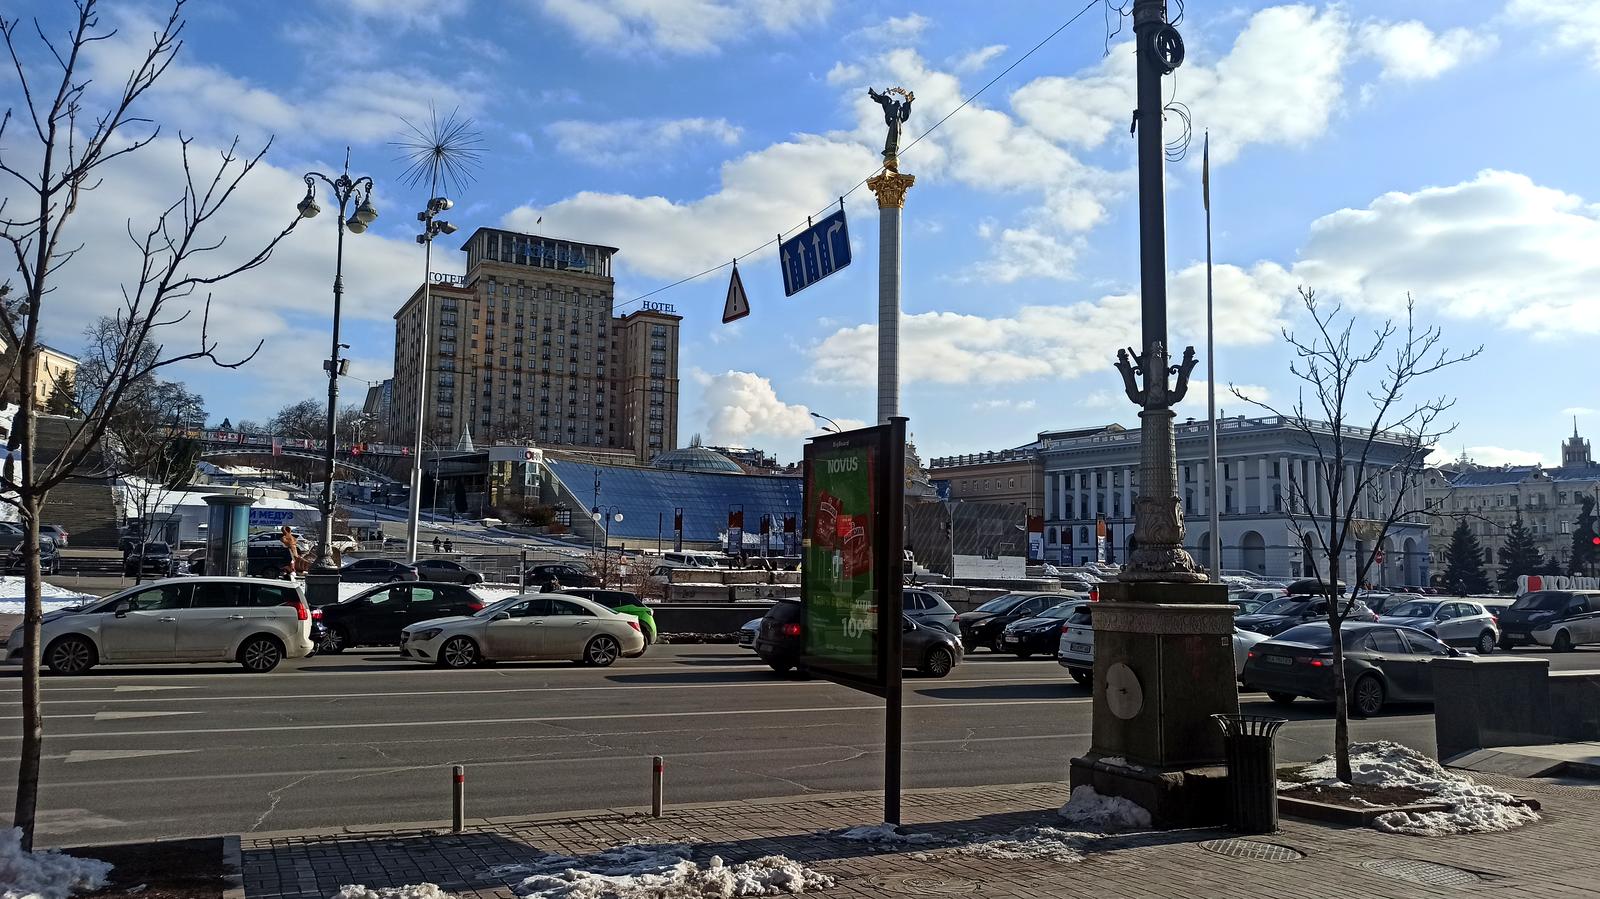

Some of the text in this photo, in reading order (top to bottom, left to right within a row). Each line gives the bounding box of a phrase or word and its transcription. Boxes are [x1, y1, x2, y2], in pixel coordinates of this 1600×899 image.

[643, 300, 676, 313] HOTEL
[827, 456, 858, 474] NOVUS
[260, 510, 294, 520] МЕДУЗ
[1516, 574, 1529, 597] Я
